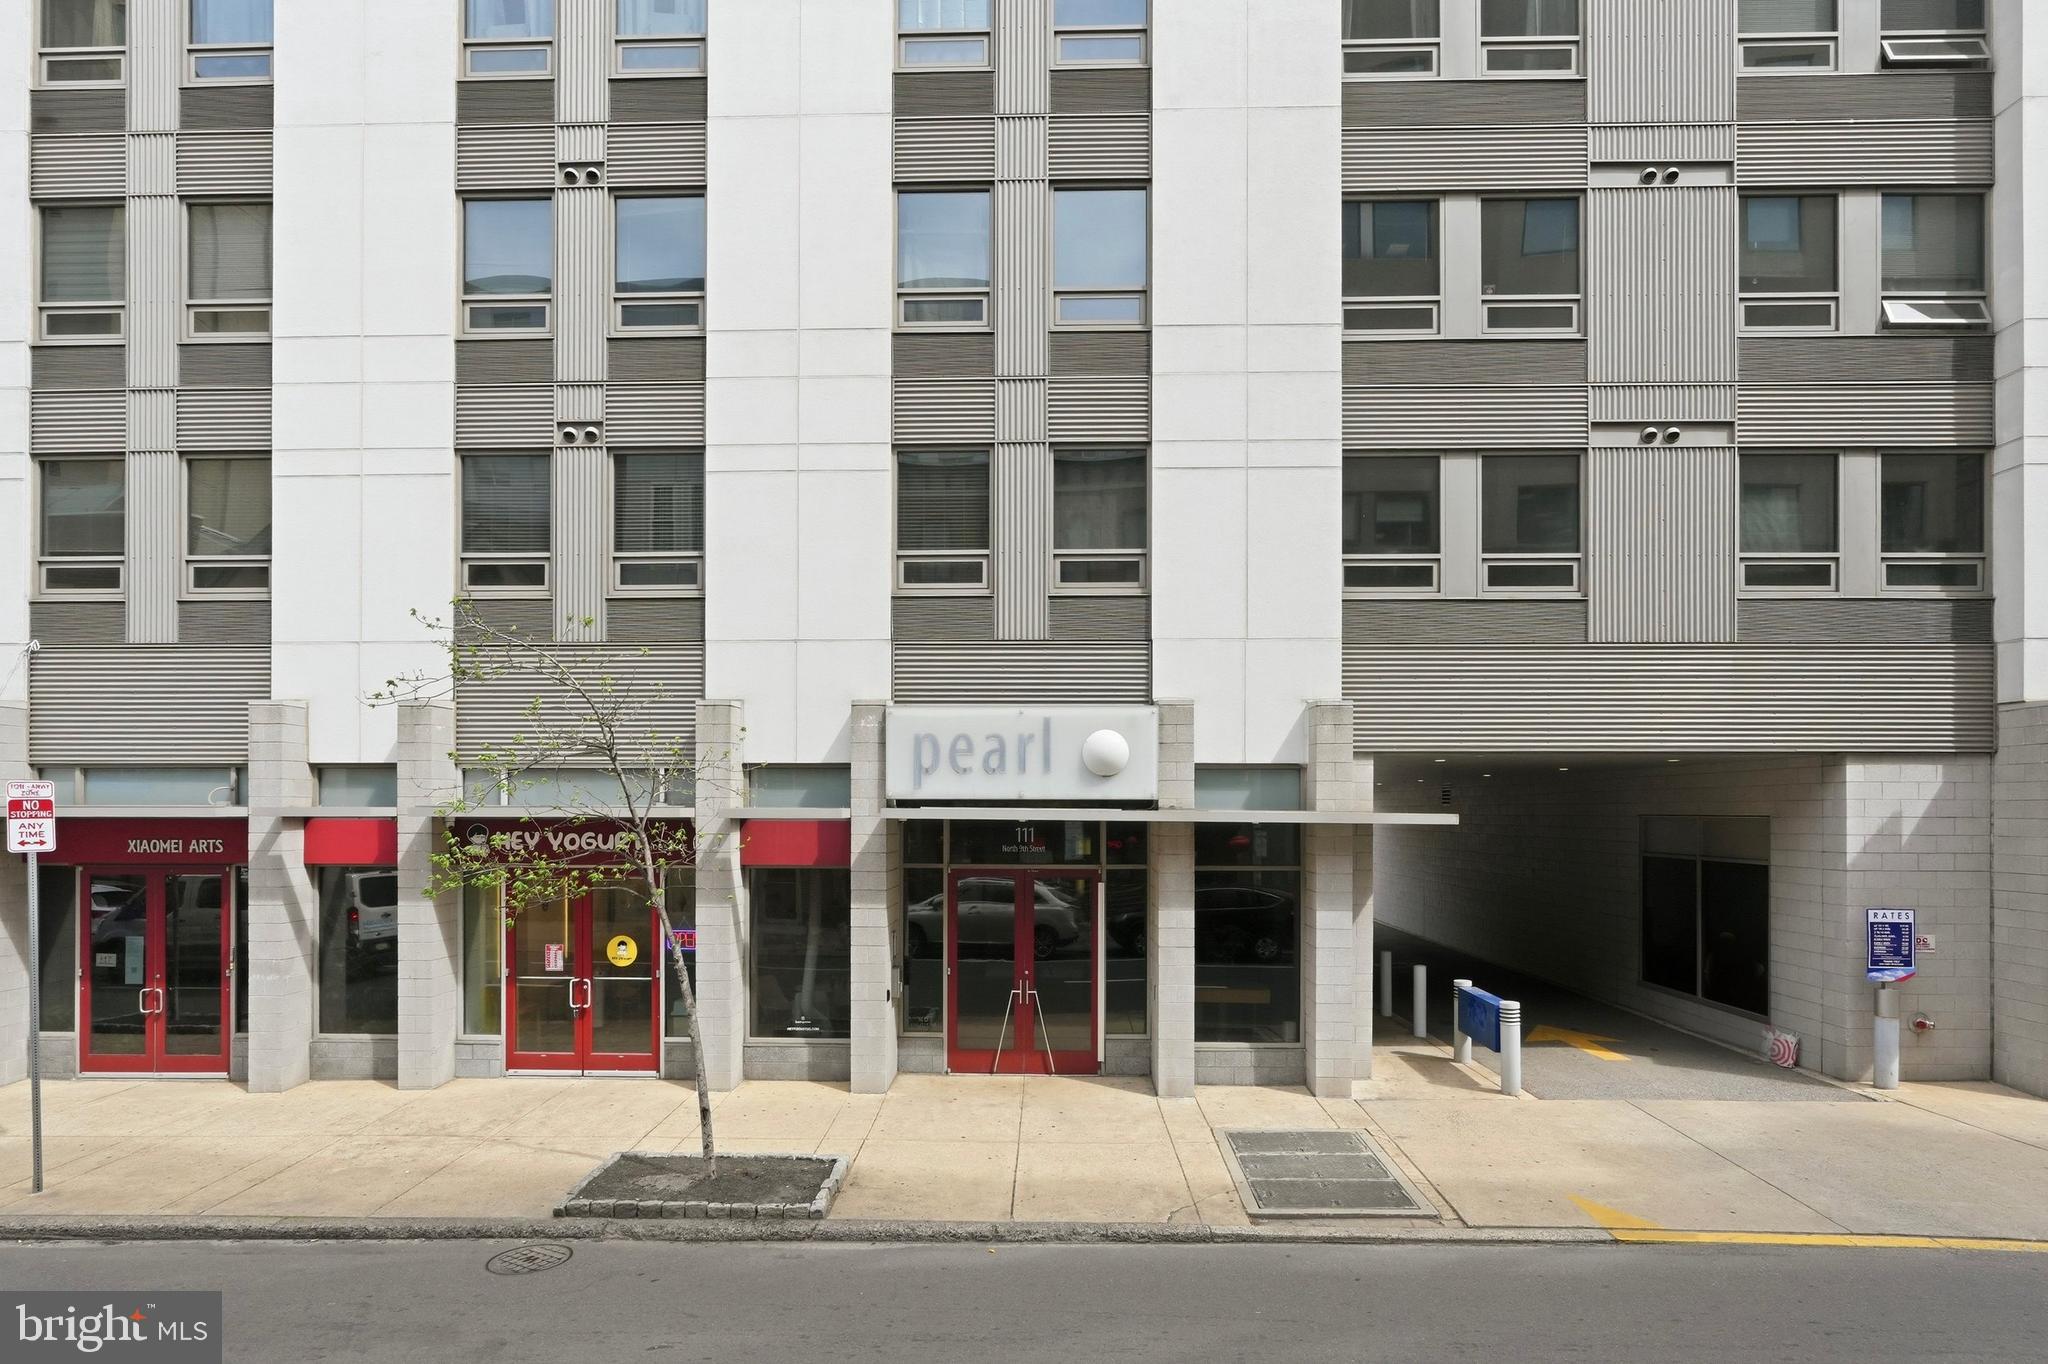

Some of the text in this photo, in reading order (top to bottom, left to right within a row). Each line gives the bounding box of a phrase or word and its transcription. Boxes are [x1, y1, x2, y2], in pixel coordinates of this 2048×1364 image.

[913, 717, 1051, 789] pearl
[22, 800, 39, 810] NO
[10, 810, 52, 818] STOPPING
[18, 822, 44, 830] ANY
[1015, 827, 1034, 842] 111
[495, 831, 540, 850] HEY
[127, 839, 224, 853] XIAOMEI ARTS
[1001, 844, 1018, 852] North
[1019, 844, 1029, 852] 9th
[1873, 911, 1910, 920] RATES
